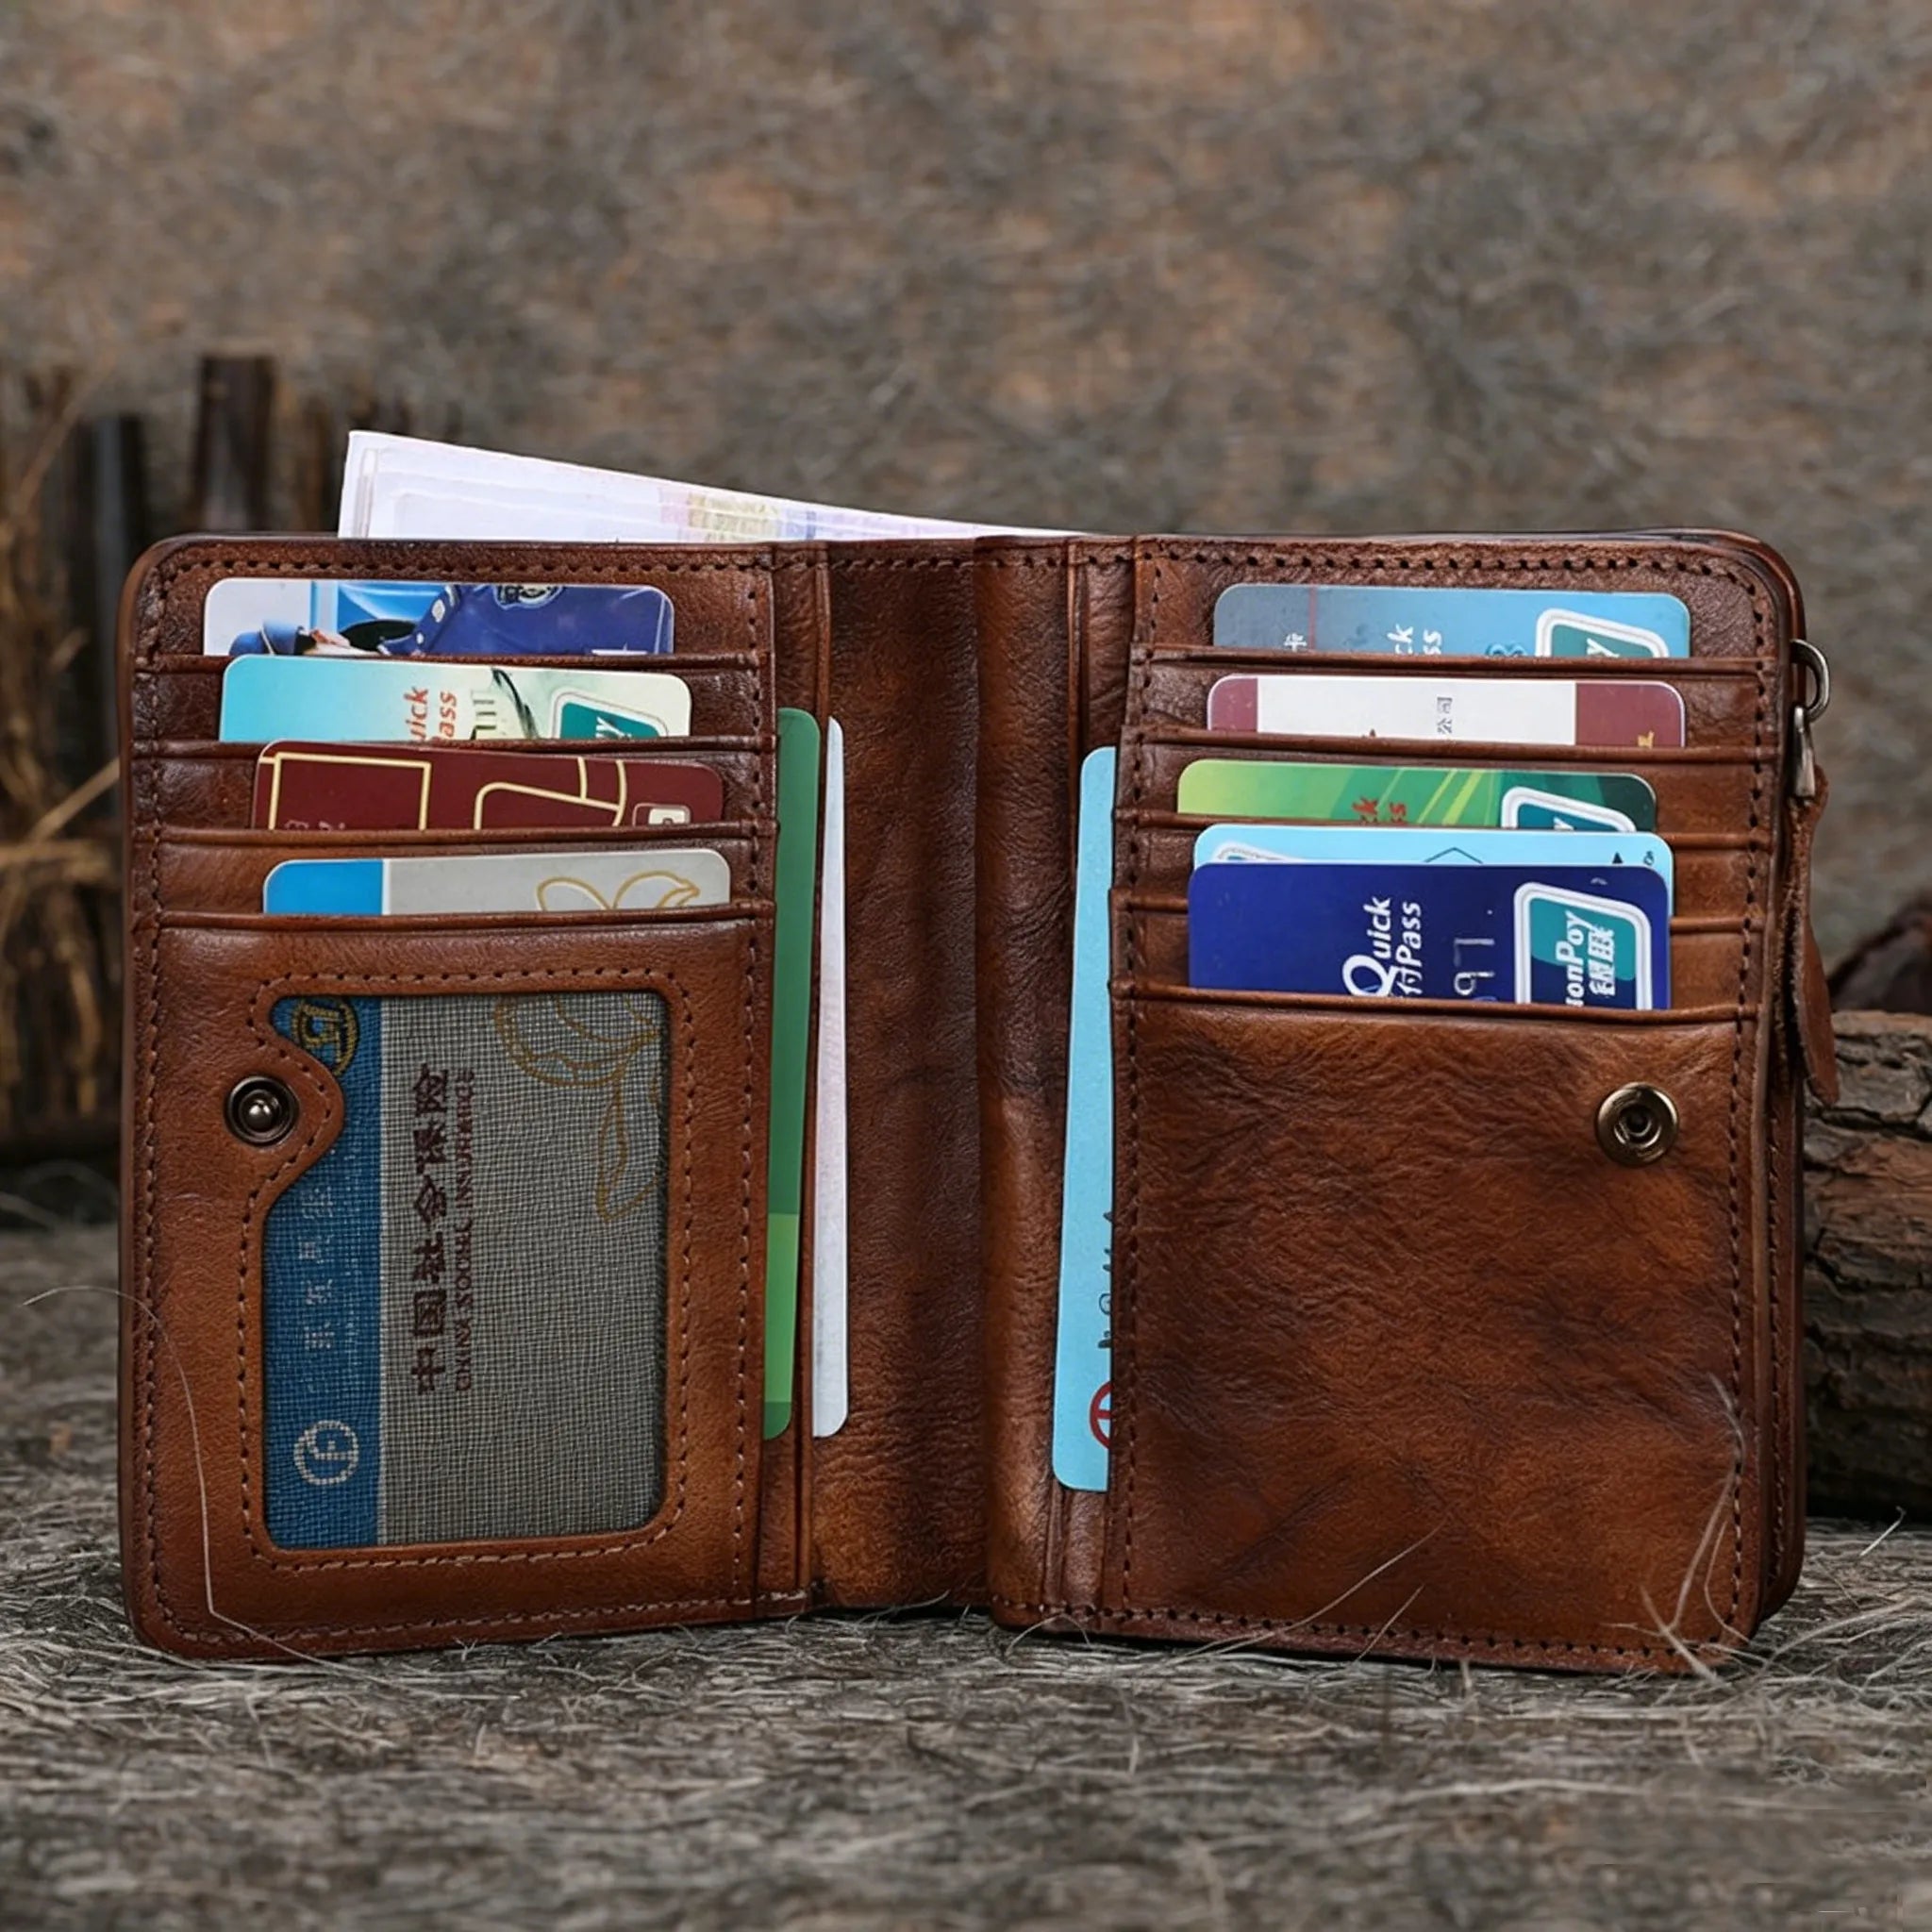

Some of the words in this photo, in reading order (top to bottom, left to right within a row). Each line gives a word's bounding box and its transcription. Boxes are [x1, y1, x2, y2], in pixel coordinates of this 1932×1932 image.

[1341, 896, 1401, 997] Quick
[411, 1062, 448, 1396] 中国社会保险
